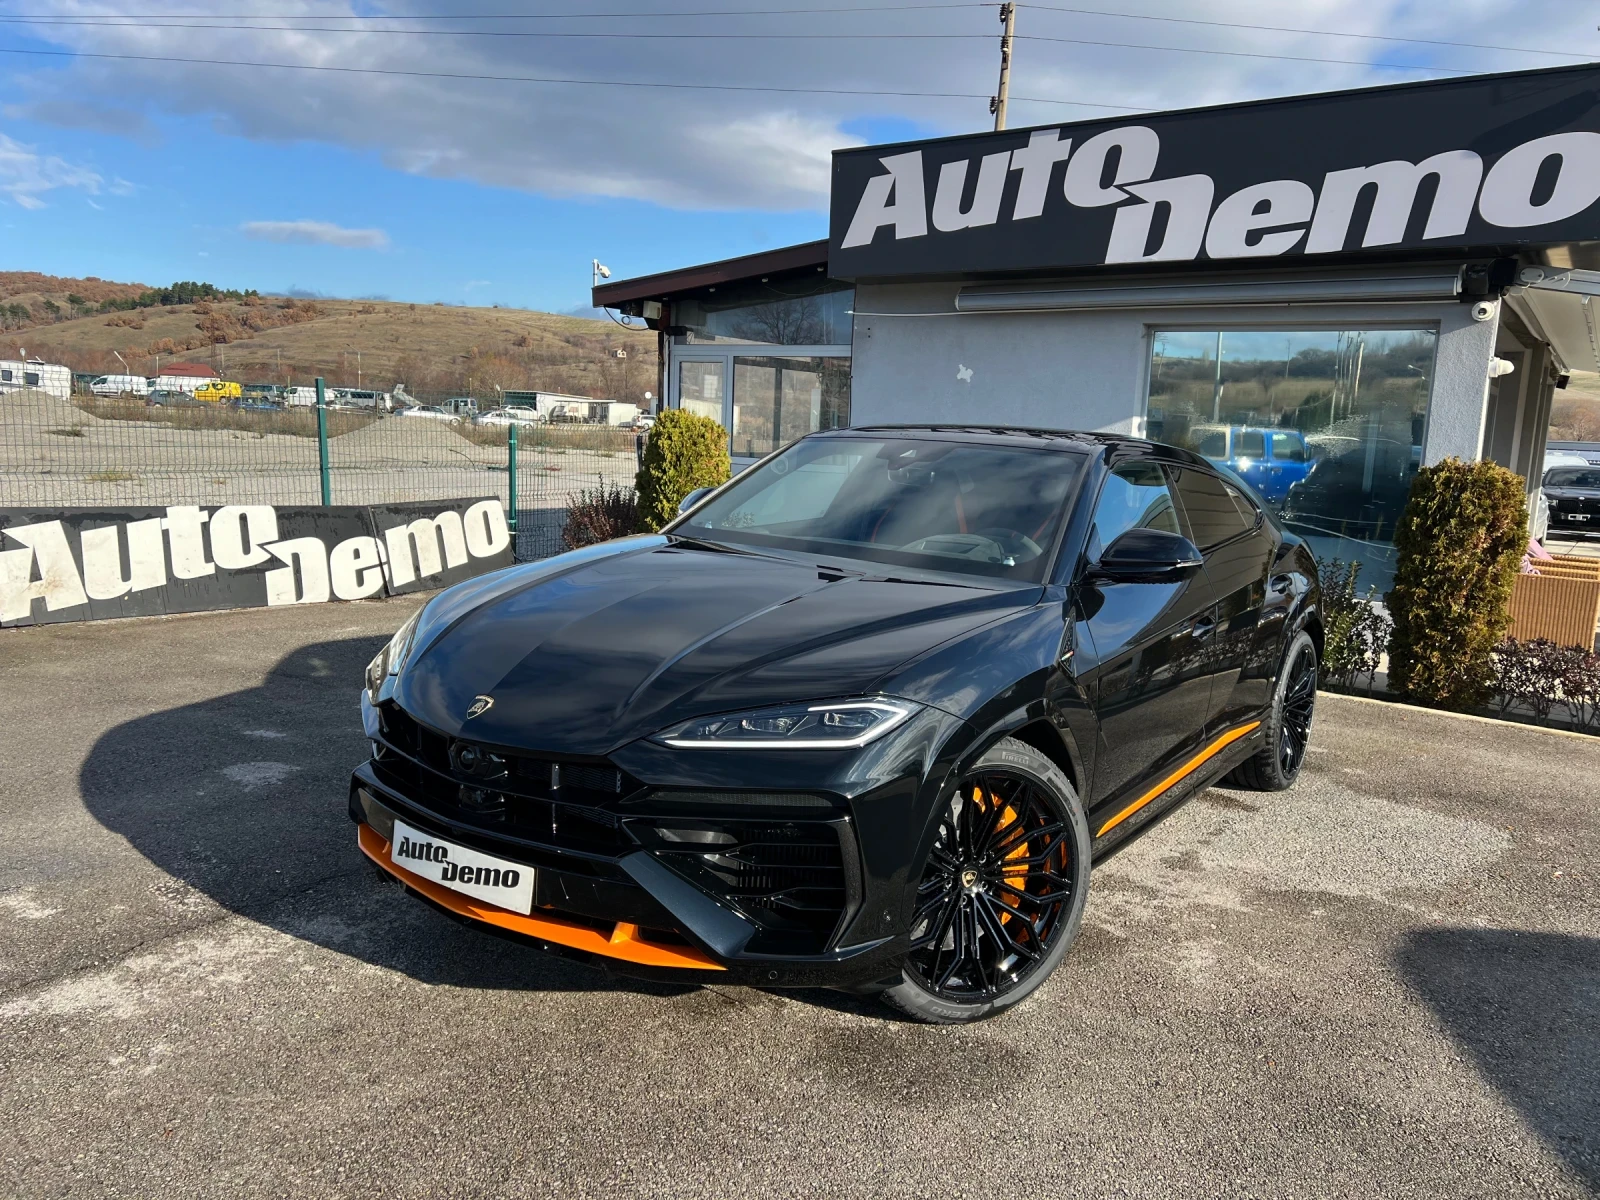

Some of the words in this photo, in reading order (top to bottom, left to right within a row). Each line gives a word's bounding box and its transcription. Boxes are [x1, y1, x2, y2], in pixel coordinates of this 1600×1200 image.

[841, 125, 1160, 249] Auto
[1105, 132, 1600, 264] Demo
[0, 505, 280, 622] Auto
[263, 500, 511, 606] Demo
[1002, 751, 1029, 765] PIRELLI
[397, 836, 448, 863] Auto
[441, 859, 520, 888] Demo
